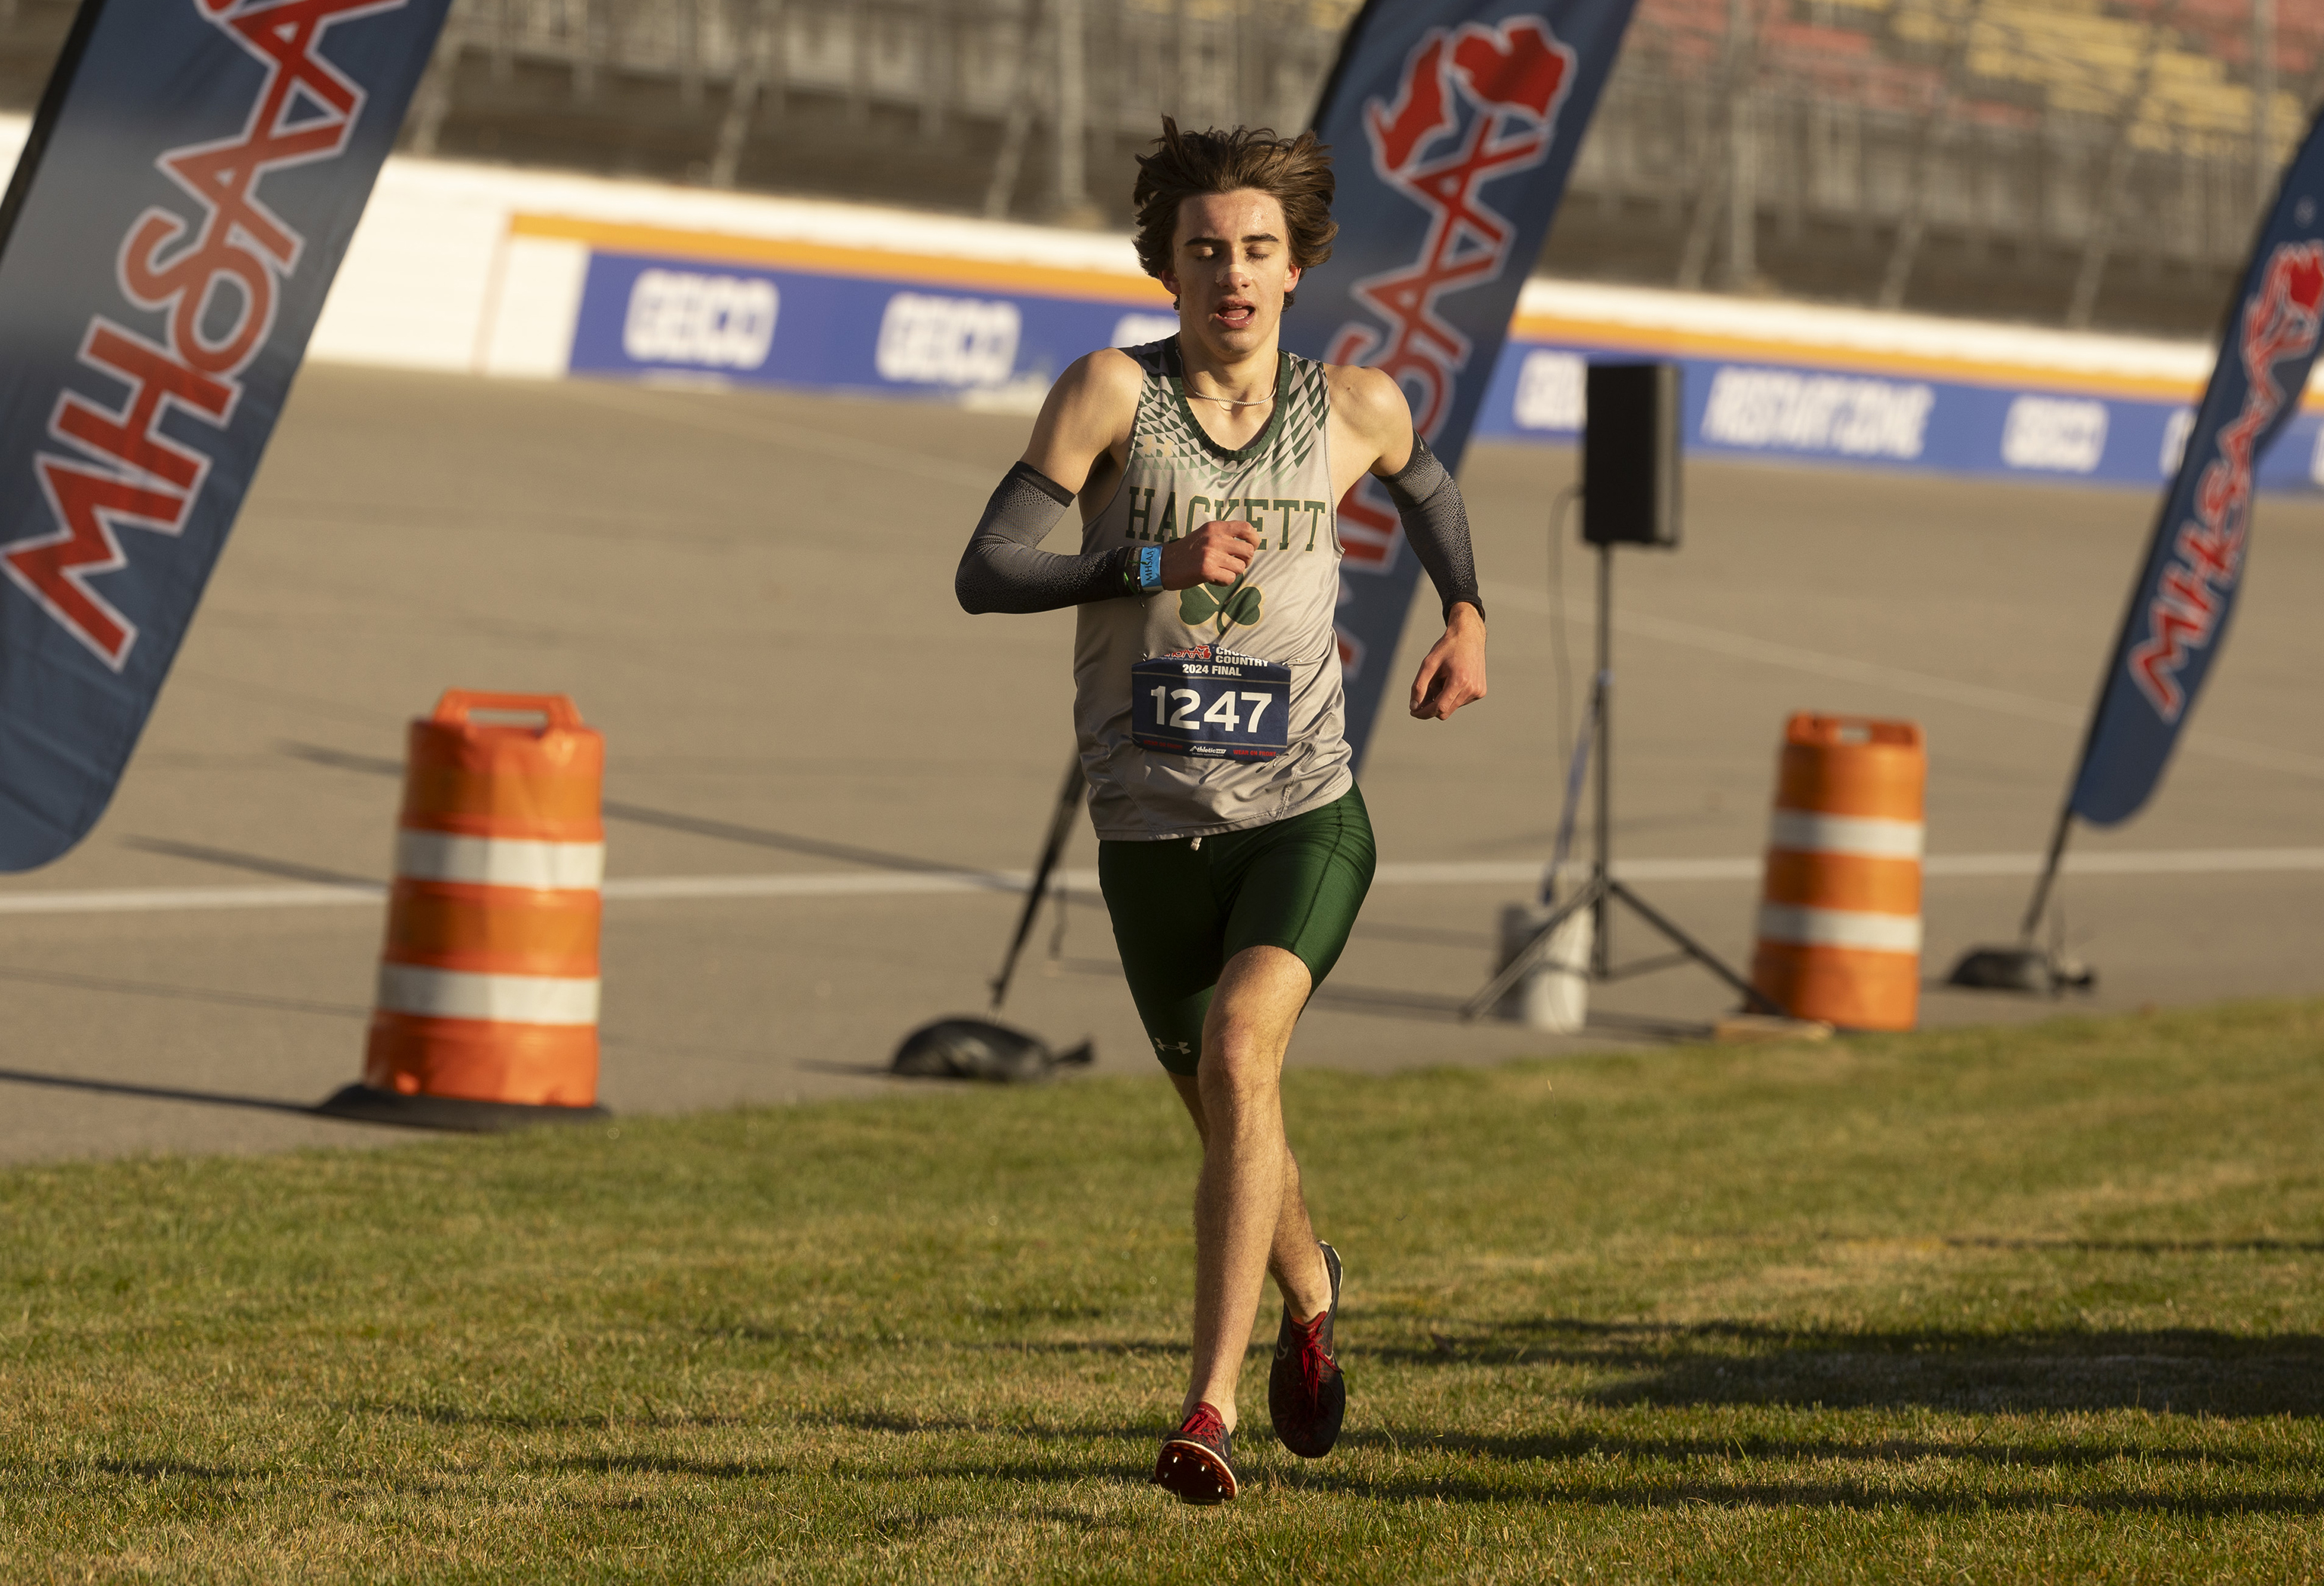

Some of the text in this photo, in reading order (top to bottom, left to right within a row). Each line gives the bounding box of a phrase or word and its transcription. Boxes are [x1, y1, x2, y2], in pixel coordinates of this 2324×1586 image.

[1215, 655, 1268, 667] COUNTRY
[1182, 664, 1242, 676] 2024 FINAL
[1151, 685, 1272, 733] 1247
